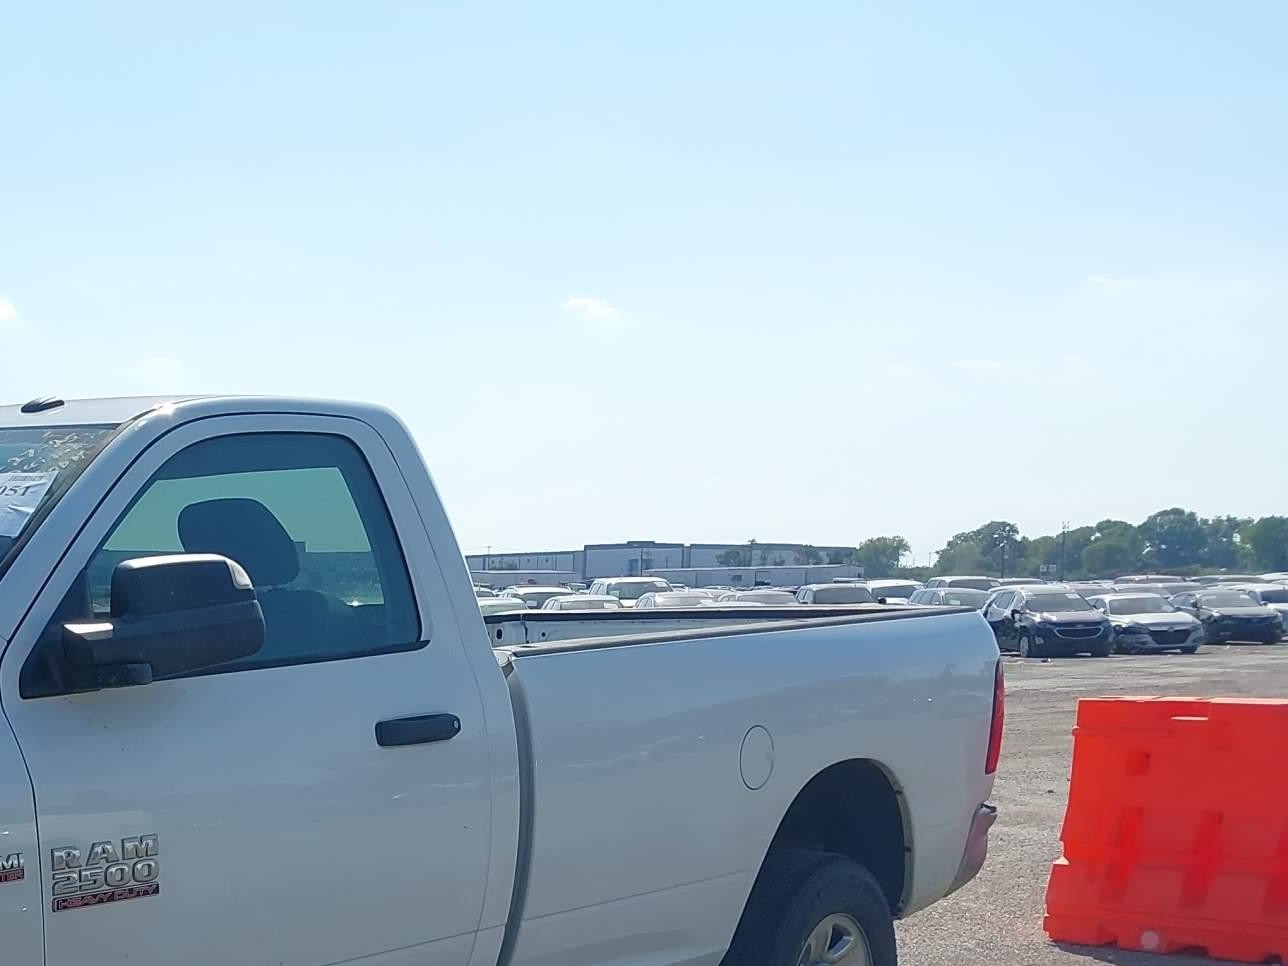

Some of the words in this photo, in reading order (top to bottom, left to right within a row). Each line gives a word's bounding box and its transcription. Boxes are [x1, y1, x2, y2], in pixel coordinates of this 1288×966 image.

[51, 833, 159, 872] RAM
[52, 858, 160, 896] 2500
[55, 892, 114, 911] HEAVY
[113, 883, 159, 902] DUTY
